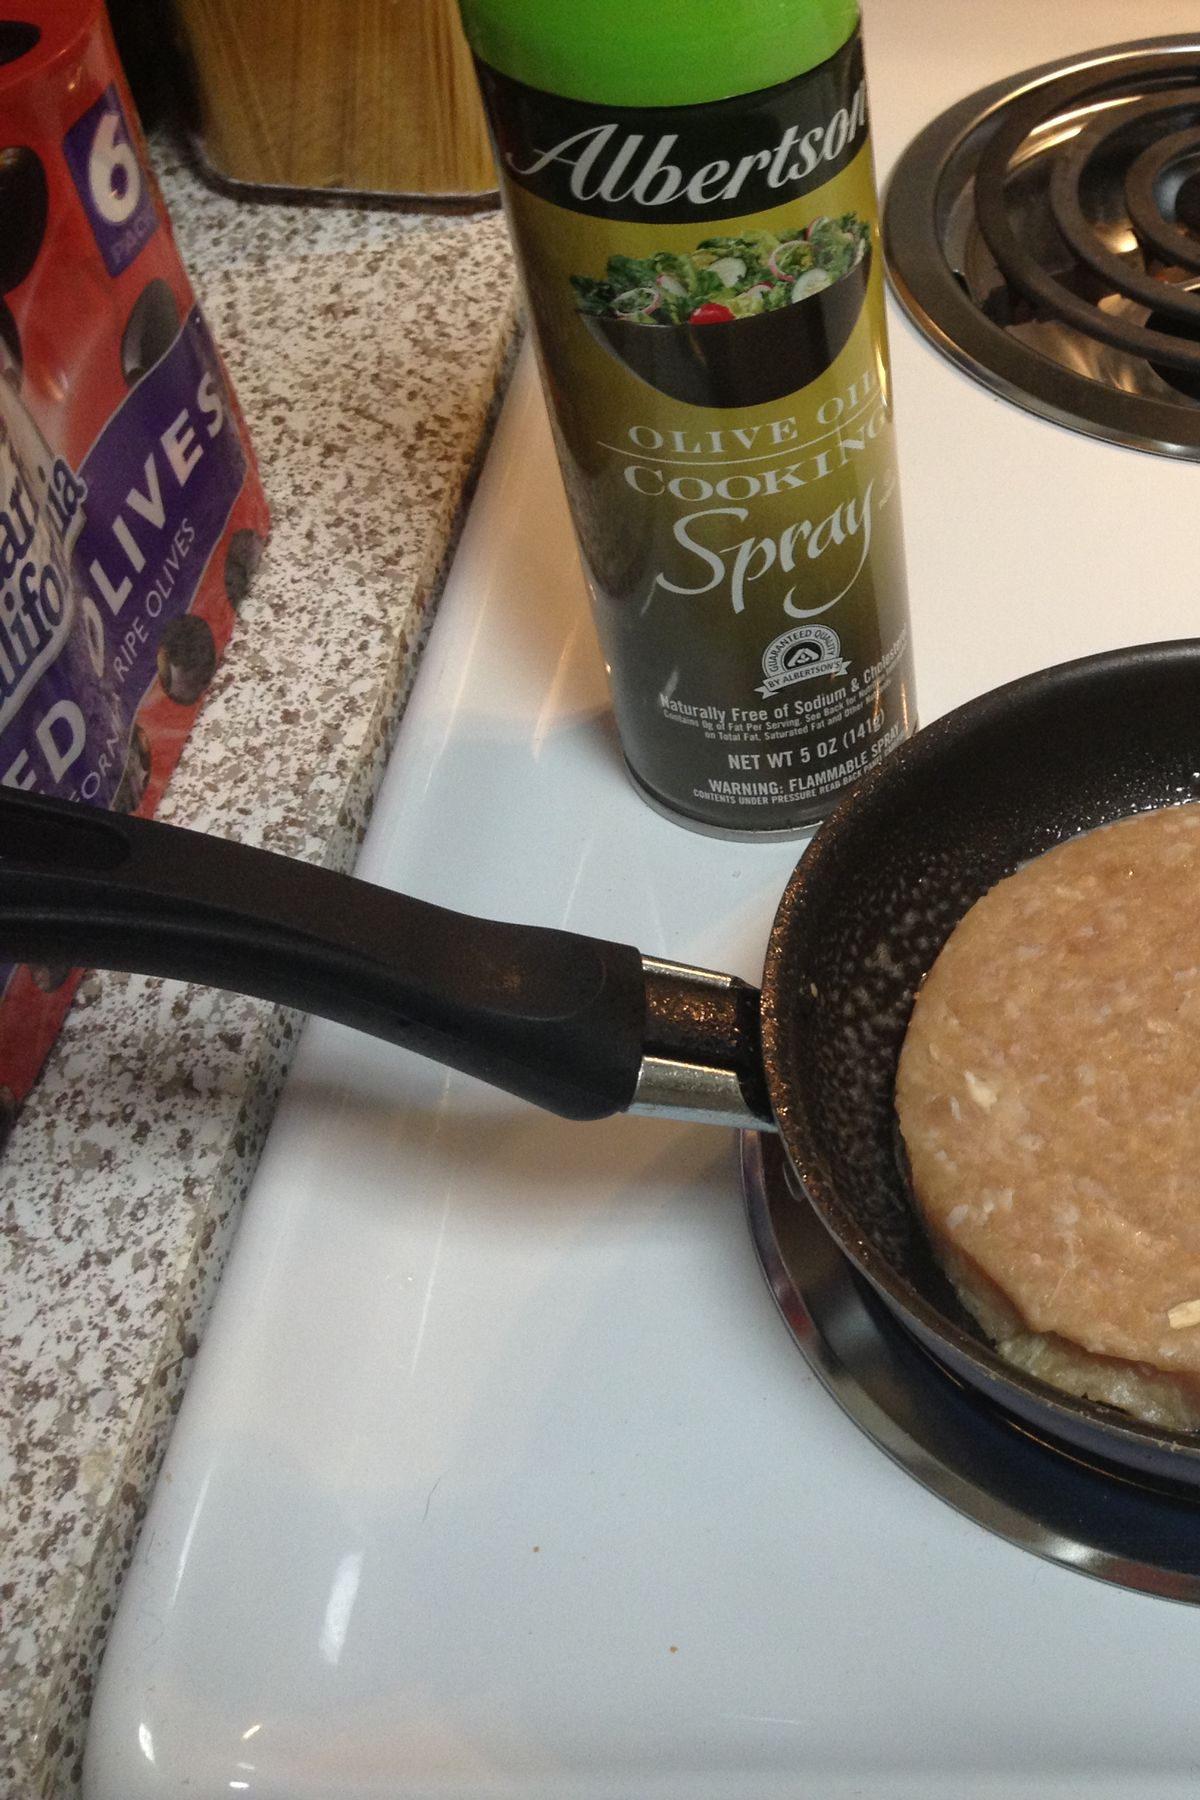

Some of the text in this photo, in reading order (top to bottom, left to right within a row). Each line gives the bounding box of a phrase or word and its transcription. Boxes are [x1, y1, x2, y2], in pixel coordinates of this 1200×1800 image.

[88, 112, 141, 226] 6
[623, 407, 886, 502] COOKING
[627, 416, 800, 454] OLIVE
[655, 480, 875, 620] Spray
[112, 517, 196, 683] RIPE OLIVES
[767, 629, 836, 673] GUARANTEED QUALITY
[767, 659, 840, 688] BY ALBERTSON'S
[659, 692, 726, 723] Naturally
[731, 707, 768, 722] Free
[773, 703, 789, 719] of
[794, 687, 847, 715] Sodium
[850, 677, 860, 692] &
[716, 721, 726, 731] of
[728, 722, 744, 732] Fat
[746, 722, 763, 732] Per
[804, 712, 822, 723] See
[823, 702, 845, 717] Back
[718, 731, 741, 741] Total
[763, 724, 809, 741] Saturated
[810, 719, 826, 732] Fat
[827, 711, 843, 727] and
[844, 702, 864, 718] Other
[708, 778, 784, 797] WARNING:
[788, 750, 869, 793] FLAMMABLE
[870, 723, 901, 759] SPRAY
[727, 753, 761, 771] NET
[766, 750, 794, 770] WT
[800, 746, 811, 763] 5
[816, 737, 839, 759] OZ
[842, 707, 886, 750] (141g)
[692, 788, 737, 805] CONTENTS
[738, 797, 770, 806] UNDER
[771, 788, 818, 805] PRESSURE
[819, 780, 841, 795] READ
[842, 770, 863, 787] BACK
